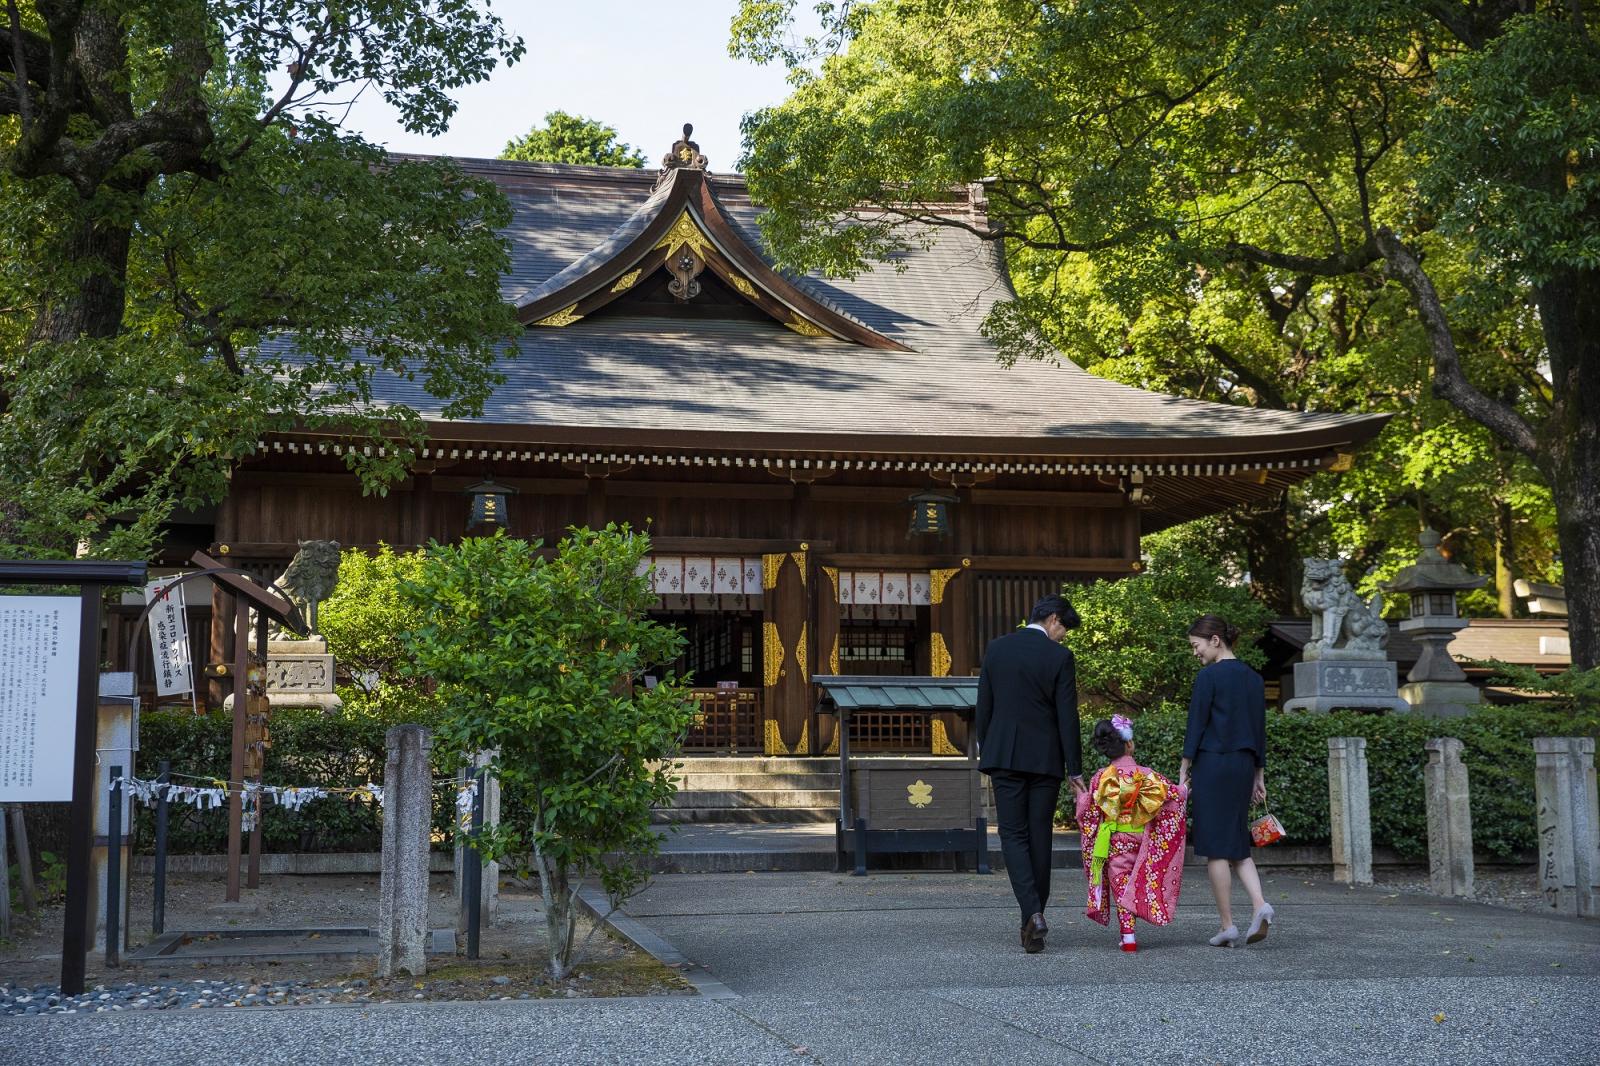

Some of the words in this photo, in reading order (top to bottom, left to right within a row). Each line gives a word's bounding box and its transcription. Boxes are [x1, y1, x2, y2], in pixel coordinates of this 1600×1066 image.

[157, 621, 173, 688] 感染症流行鎮静
[166, 604, 183, 678] 新型コロナウイルス
